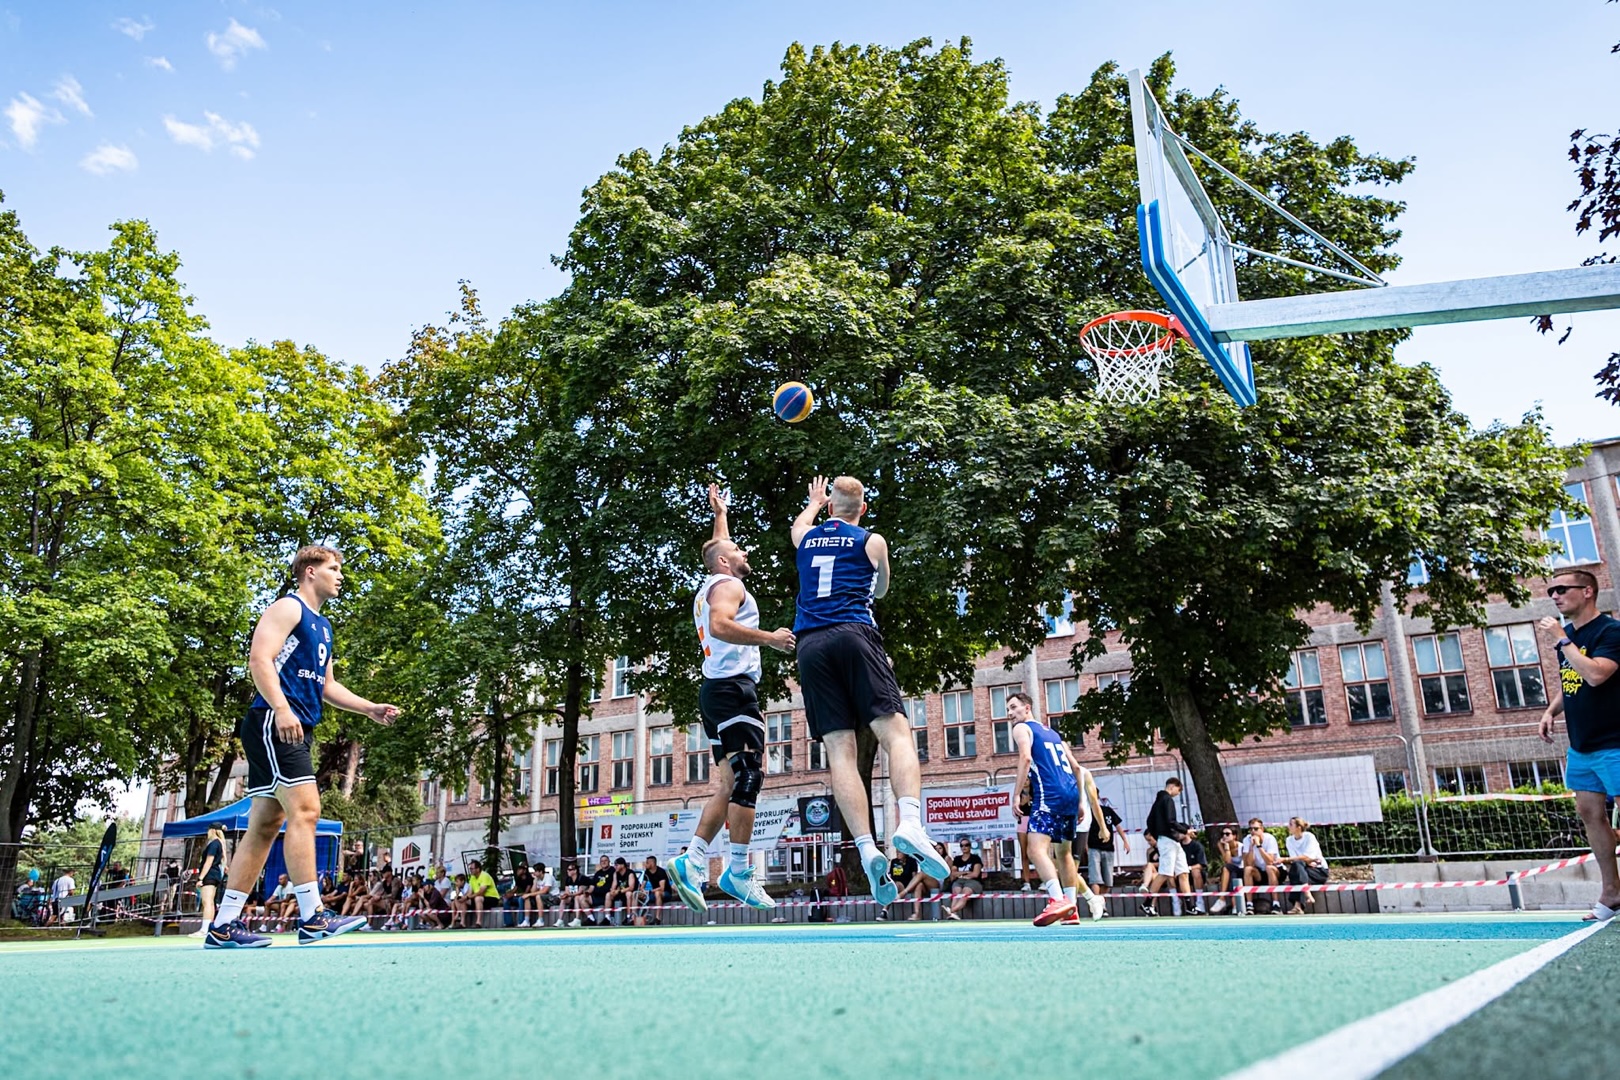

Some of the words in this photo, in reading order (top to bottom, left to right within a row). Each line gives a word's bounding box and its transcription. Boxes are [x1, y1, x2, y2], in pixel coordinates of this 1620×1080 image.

[318, 643, 327, 666] 9
[297, 668, 316, 680] SBA
[1562, 681, 1582, 694] FEST
[1044, 742, 1072, 774] 13
[928, 797, 970, 810] Spoľahlivý
[972, 795, 1007, 808] partner
[755, 808, 793, 818] DPORUJEME
[928, 812, 943, 822] pre
[944, 810, 964, 820] vašu
[966, 808, 996, 818] stavbu
[620, 822, 663, 830] PODPORUJEME
[754, 816, 782, 828] OVENSKÝ
[620, 830, 654, 839] SLOVENSKÝ
[394, 866, 426, 880] HGC
